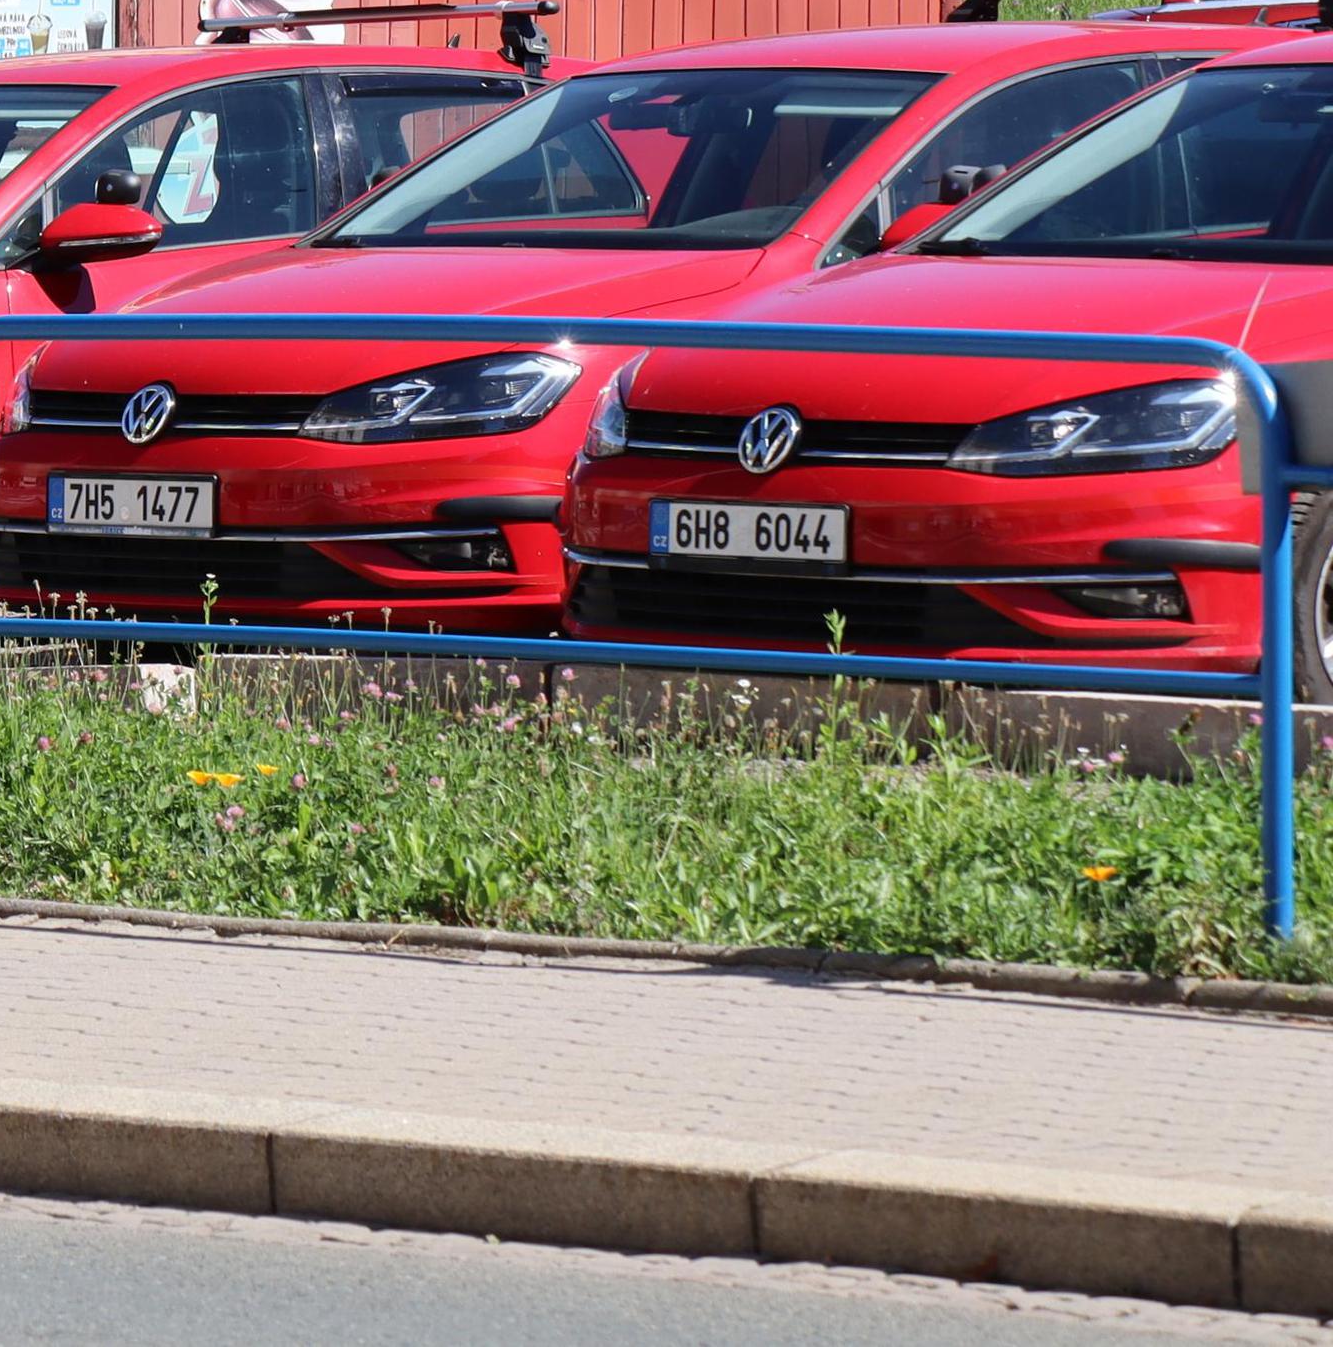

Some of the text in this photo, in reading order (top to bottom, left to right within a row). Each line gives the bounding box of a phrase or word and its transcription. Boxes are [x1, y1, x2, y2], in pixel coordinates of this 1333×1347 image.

[51, 483, 199, 523] CZ 7H5 1477
[653, 508, 830, 554] CZ 6H8 6044
